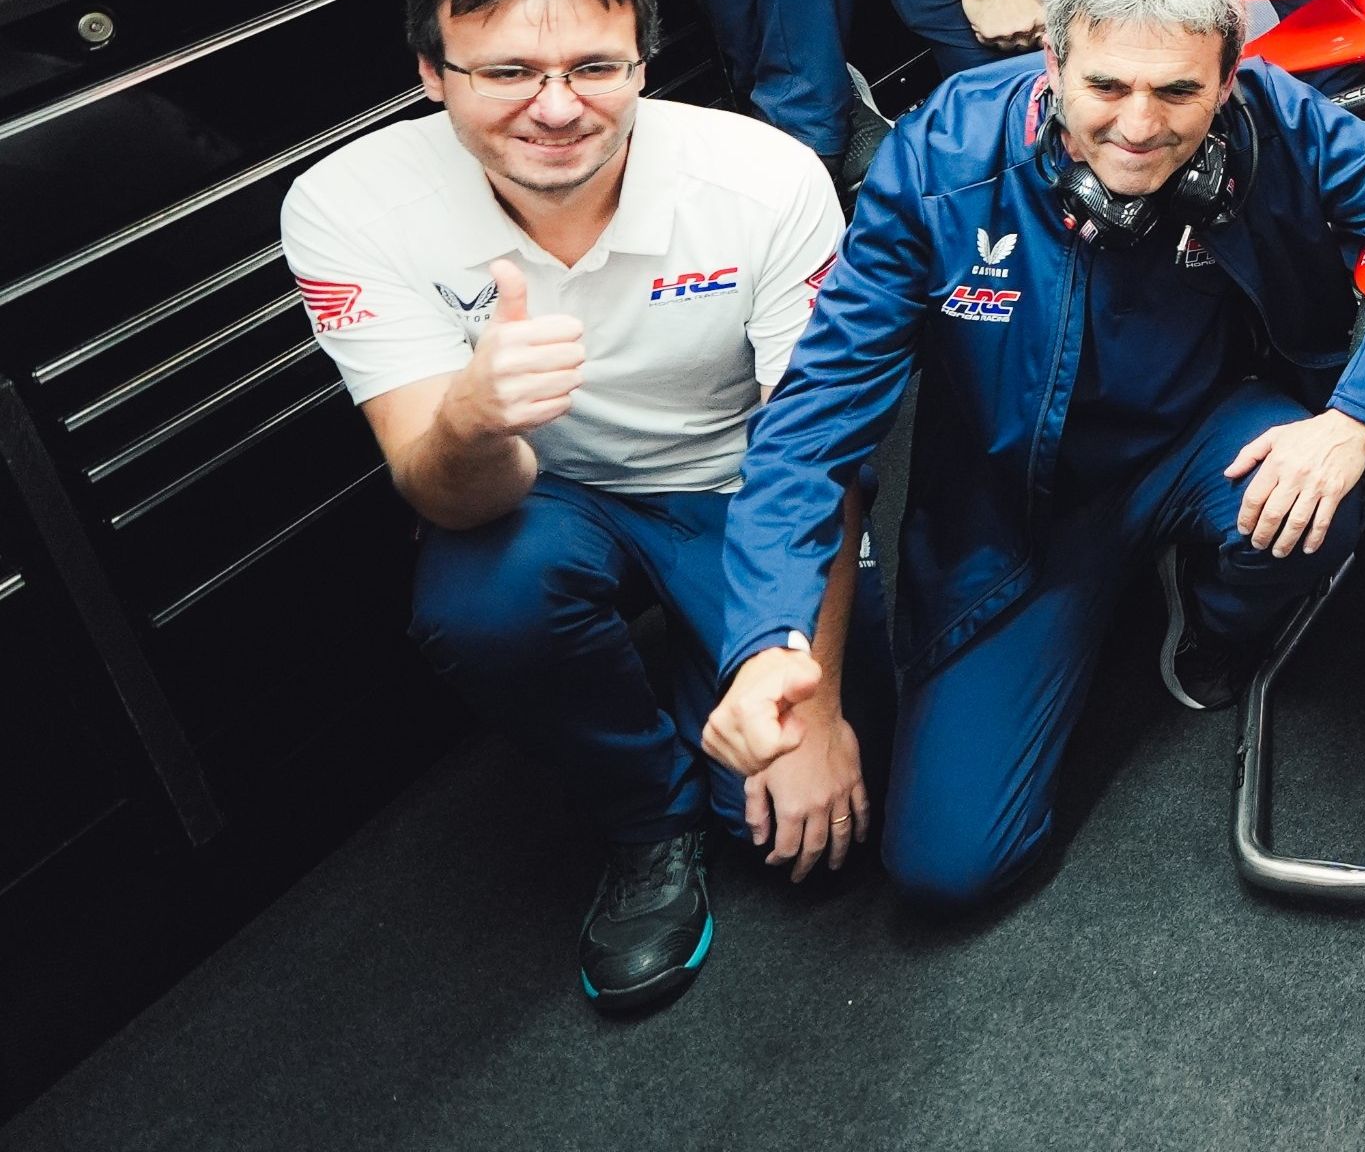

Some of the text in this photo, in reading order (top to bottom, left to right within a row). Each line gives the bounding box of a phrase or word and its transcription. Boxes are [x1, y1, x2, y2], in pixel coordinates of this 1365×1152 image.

[971, 265, 1010, 278] CASTORE
[650, 266, 738, 301] HRC
[691, 288, 740, 301] RACING
[941, 284, 1022, 317] HRC
[940, 307, 1011, 323] Honda RACING
